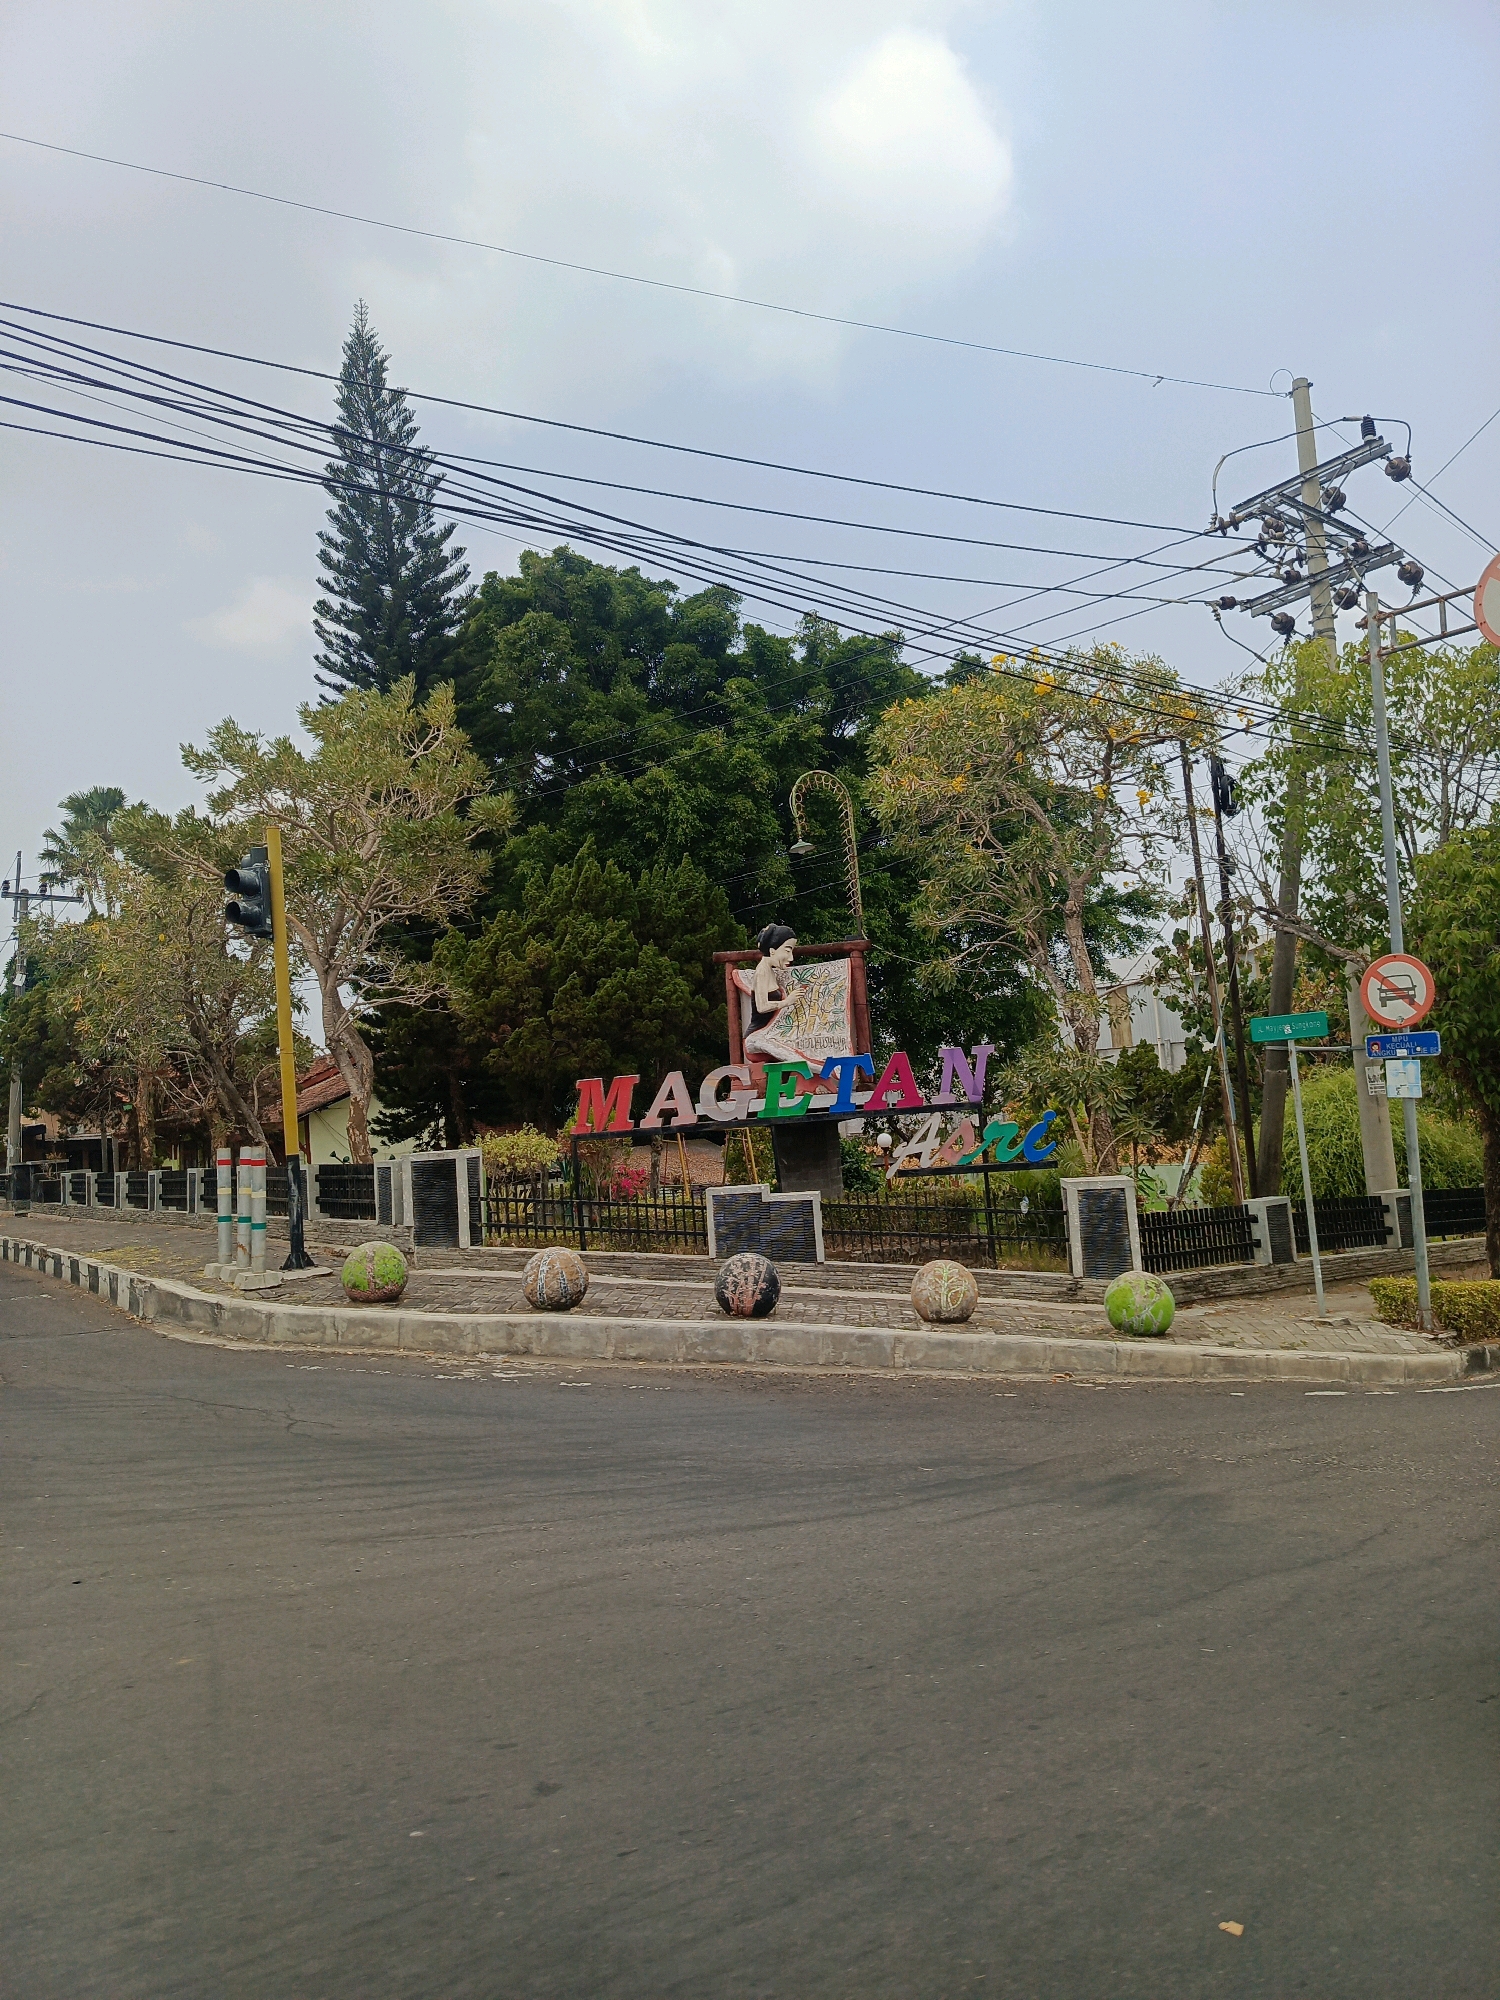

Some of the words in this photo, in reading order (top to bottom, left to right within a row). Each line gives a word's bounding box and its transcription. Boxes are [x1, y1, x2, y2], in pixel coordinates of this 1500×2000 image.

[1385, 1041, 1418, 1050] KECUALI
[1391, 1035, 1409, 1043] MPU
[570, 1044, 995, 1136] MAGETAN
[886, 1110, 1057, 1180] Asri
